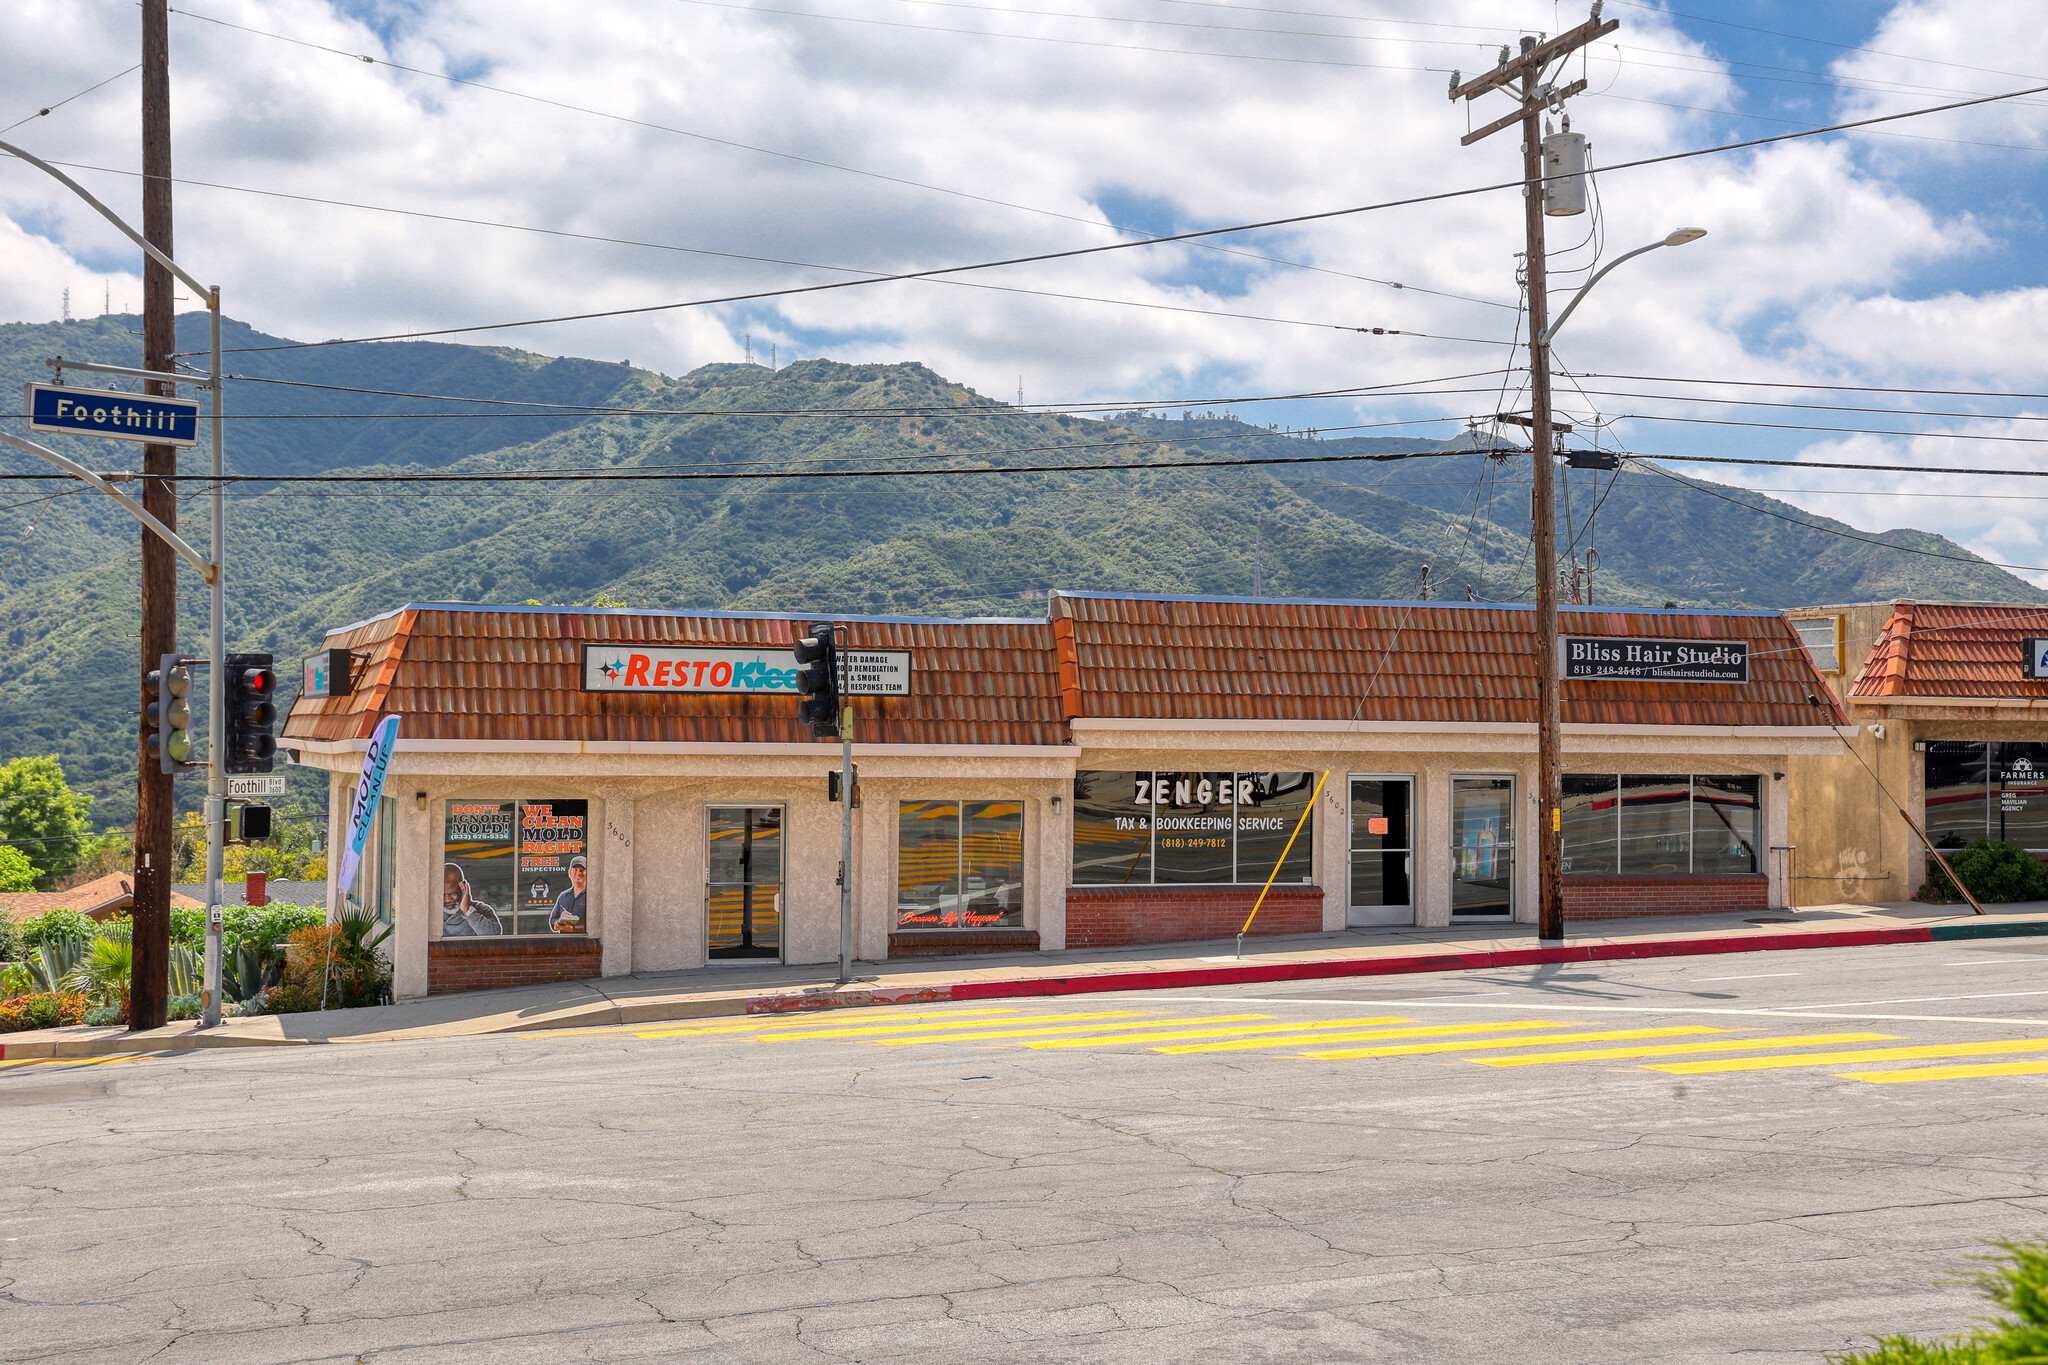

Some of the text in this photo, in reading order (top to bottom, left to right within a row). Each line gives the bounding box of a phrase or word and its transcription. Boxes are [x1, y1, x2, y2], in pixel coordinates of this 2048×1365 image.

[56, 399, 176, 430] Foothill
[860, 656, 888, 664] DAMAGE
[1571, 643, 1742, 665] Bliss Hair Studio
[854, 665, 899, 673] REMEDIATION
[1573, 664, 1592, 674] 818
[1596, 665, 1641, 676] 248-2548
[1652, 668, 1739, 678] blisshairstudiola.com
[857, 674, 881, 682] SMOKE
[850, 683, 884, 691] RESPONSE
[886, 683, 903, 691] TEAM
[2000, 771, 2045, 779] FARMERS
[229, 780, 266, 793] Foothill
[352, 740, 379, 829] MOLD
[358, 743, 388, 842] CLEAN-UP
[1134, 779, 1255, 806] ZENGER
[1325, 790, 1345, 815] 3602
[452, 804, 501, 814] DON'T
[522, 805, 553, 816] WE
[452, 814, 511, 823] IGNORE
[522, 816, 584, 828] CLEAN
[1115, 817, 1284, 830] TAX & BOOKKEEPING SERVICE
[452, 823, 510, 834] MOLD!
[522, 828, 583, 841] MOLD
[607, 821, 631, 847] 3600
[522, 841, 582, 853] RIGHT
[1161, 838, 1226, 848] (818) 249-7812
[521, 857, 559, 866] FREE
